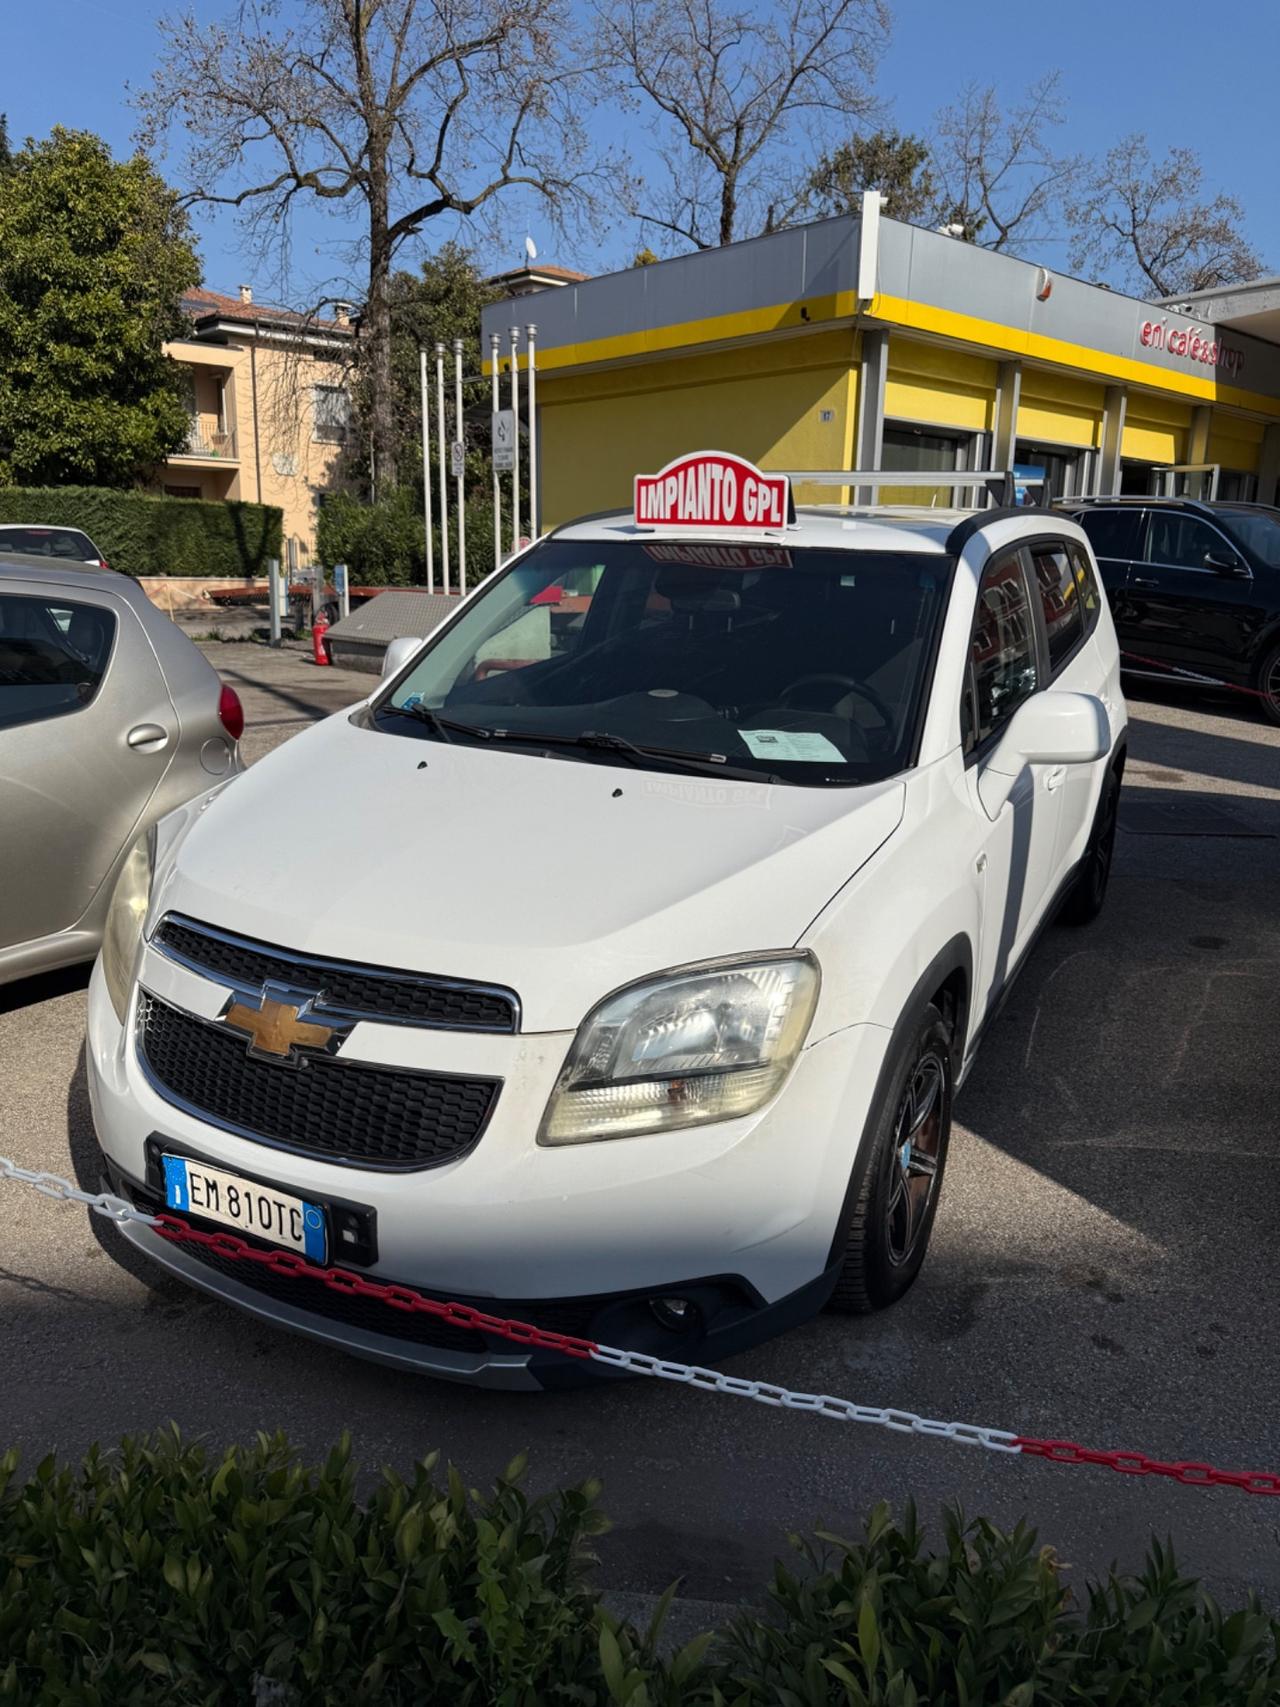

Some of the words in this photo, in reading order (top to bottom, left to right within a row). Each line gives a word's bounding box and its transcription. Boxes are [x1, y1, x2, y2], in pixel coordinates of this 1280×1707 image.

[640, 462, 738, 522] IMPIANTO
[743, 477, 782, 523] GPL
[189, 1173, 220, 1212] EM
